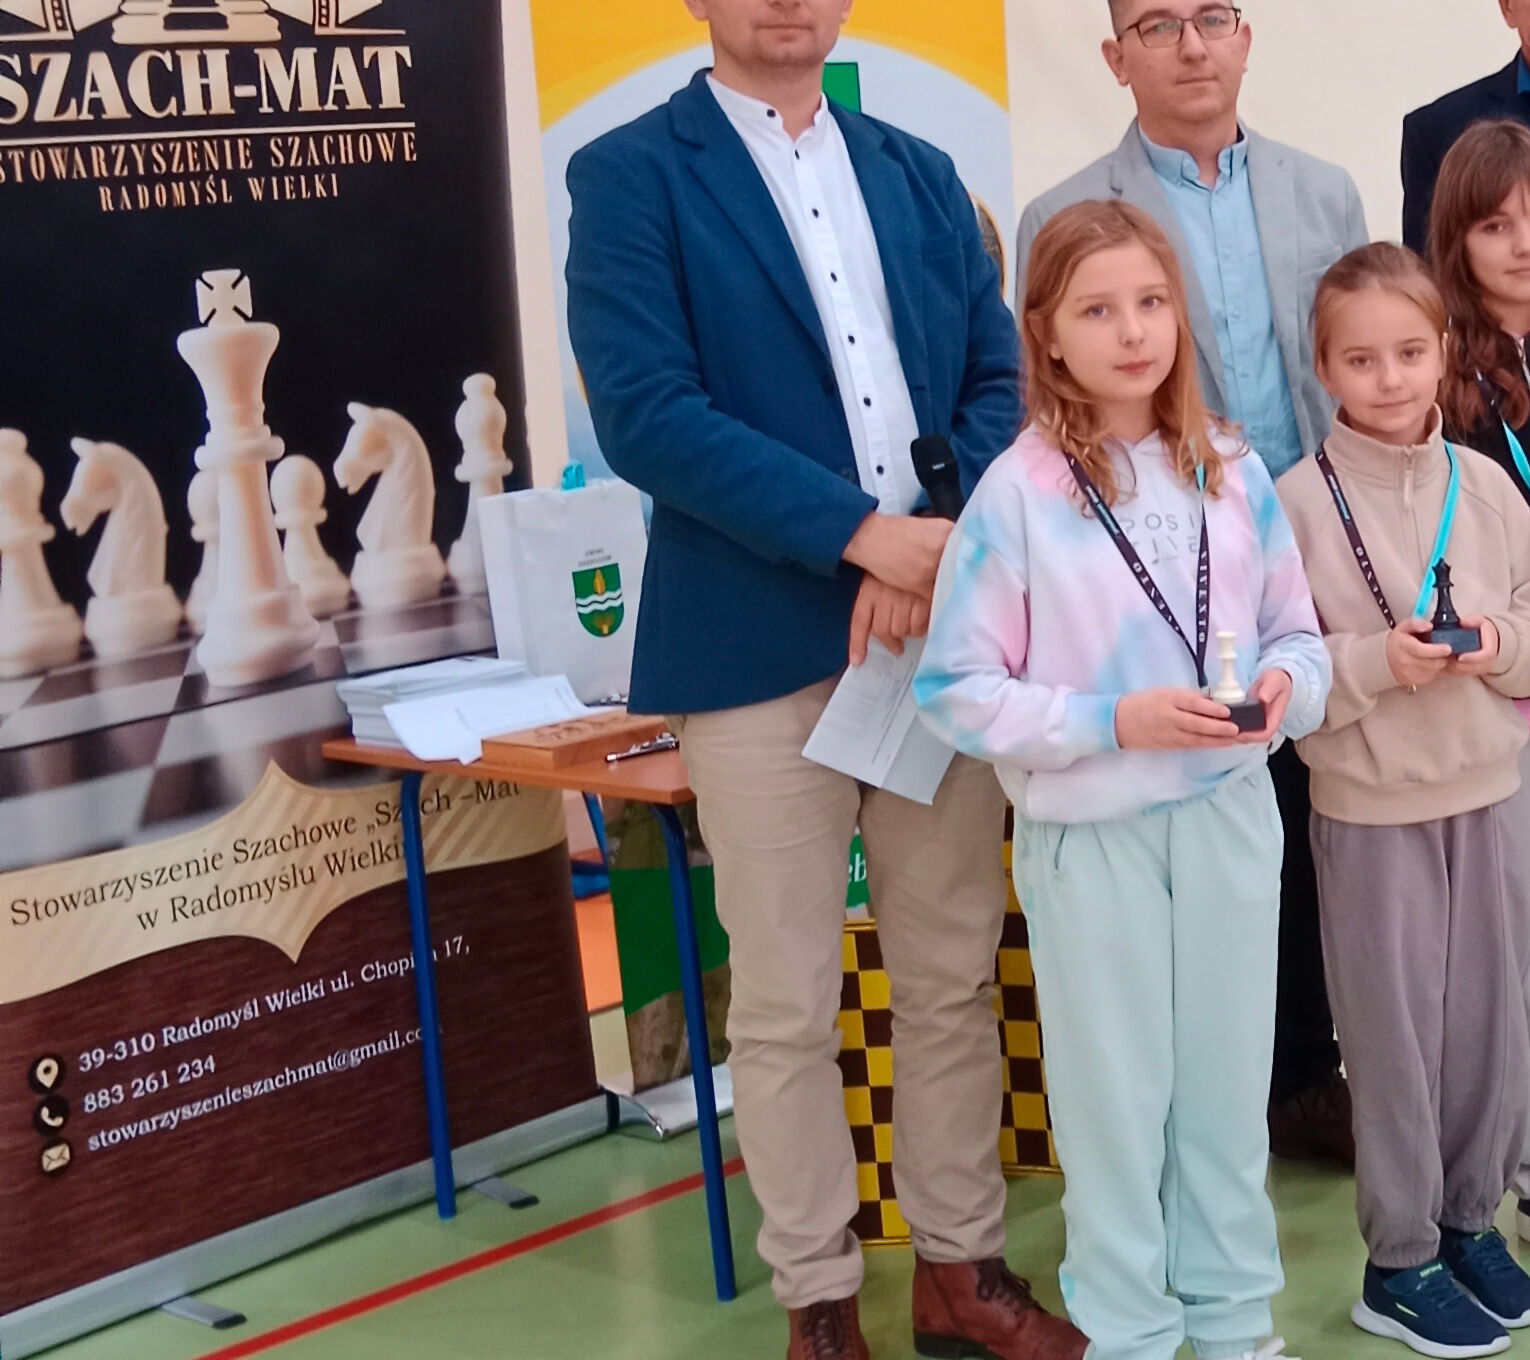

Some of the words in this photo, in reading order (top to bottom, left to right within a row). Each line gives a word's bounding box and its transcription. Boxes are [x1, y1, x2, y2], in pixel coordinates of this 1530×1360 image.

[0, 45, 413, 125] SZACH-MAT
[269, 131, 418, 168] SZACHOWE
[98, 174, 233, 212] RADOMYŚL
[247, 173, 339, 202] WIELKI
[10, 847, 225, 926] Stowarzyszenie
[232, 815, 357, 866] Szachowe
[136, 907, 159, 931] w
[170, 862, 316, 924] Radomyślu
[78, 1032, 156, 1073] 39-310
[162, 997, 261, 1048] Radomyśl
[265, 977, 326, 1014] Wielki
[331, 969, 355, 994] ul.
[444, 935, 470, 958] 17,
[83, 1083, 125, 1114] 883
[131, 1069, 170, 1100] 261
[177, 1053, 217, 1084] 234
